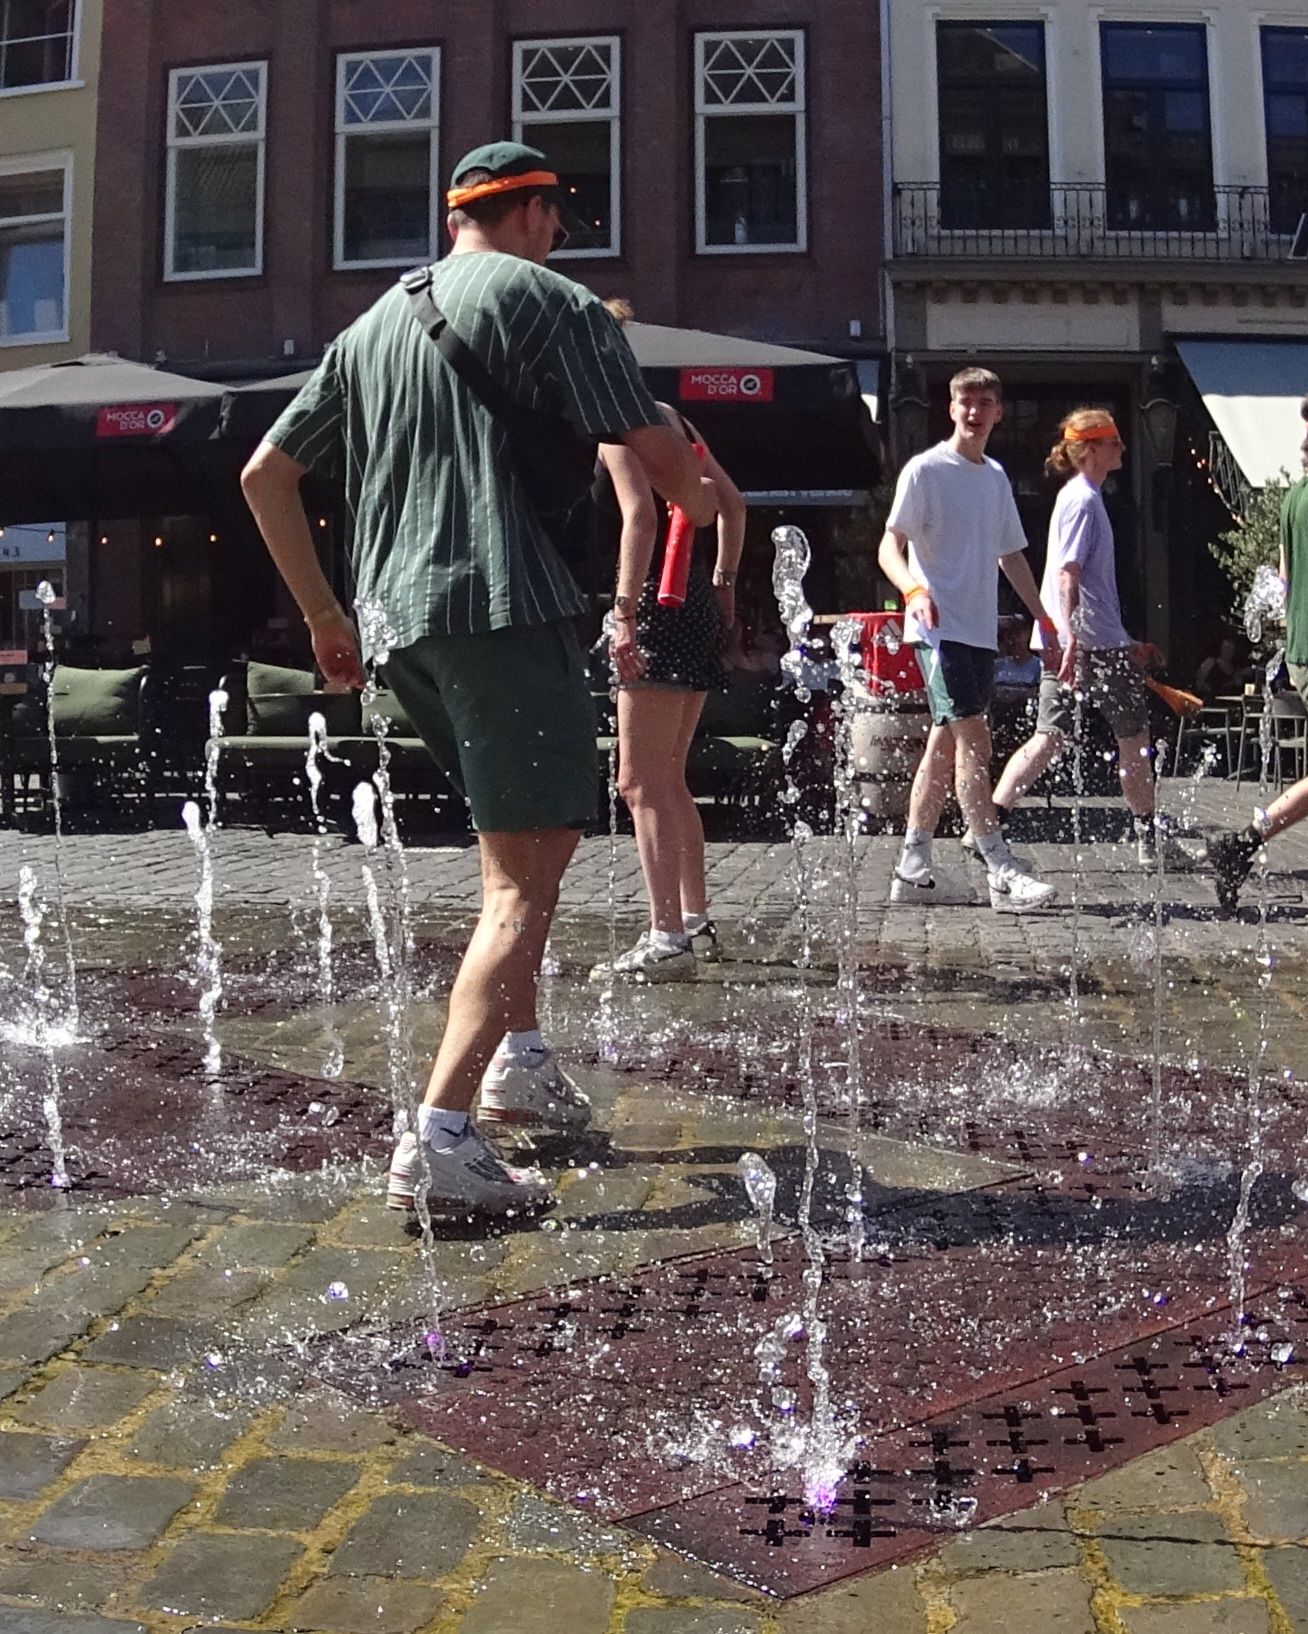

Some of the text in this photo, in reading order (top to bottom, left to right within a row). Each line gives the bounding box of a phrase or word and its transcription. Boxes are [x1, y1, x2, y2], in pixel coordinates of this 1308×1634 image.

[691, 374, 738, 385] MOCCA
[707, 384, 737, 395] D'OR
[106, 411, 145, 421] MOCCA
